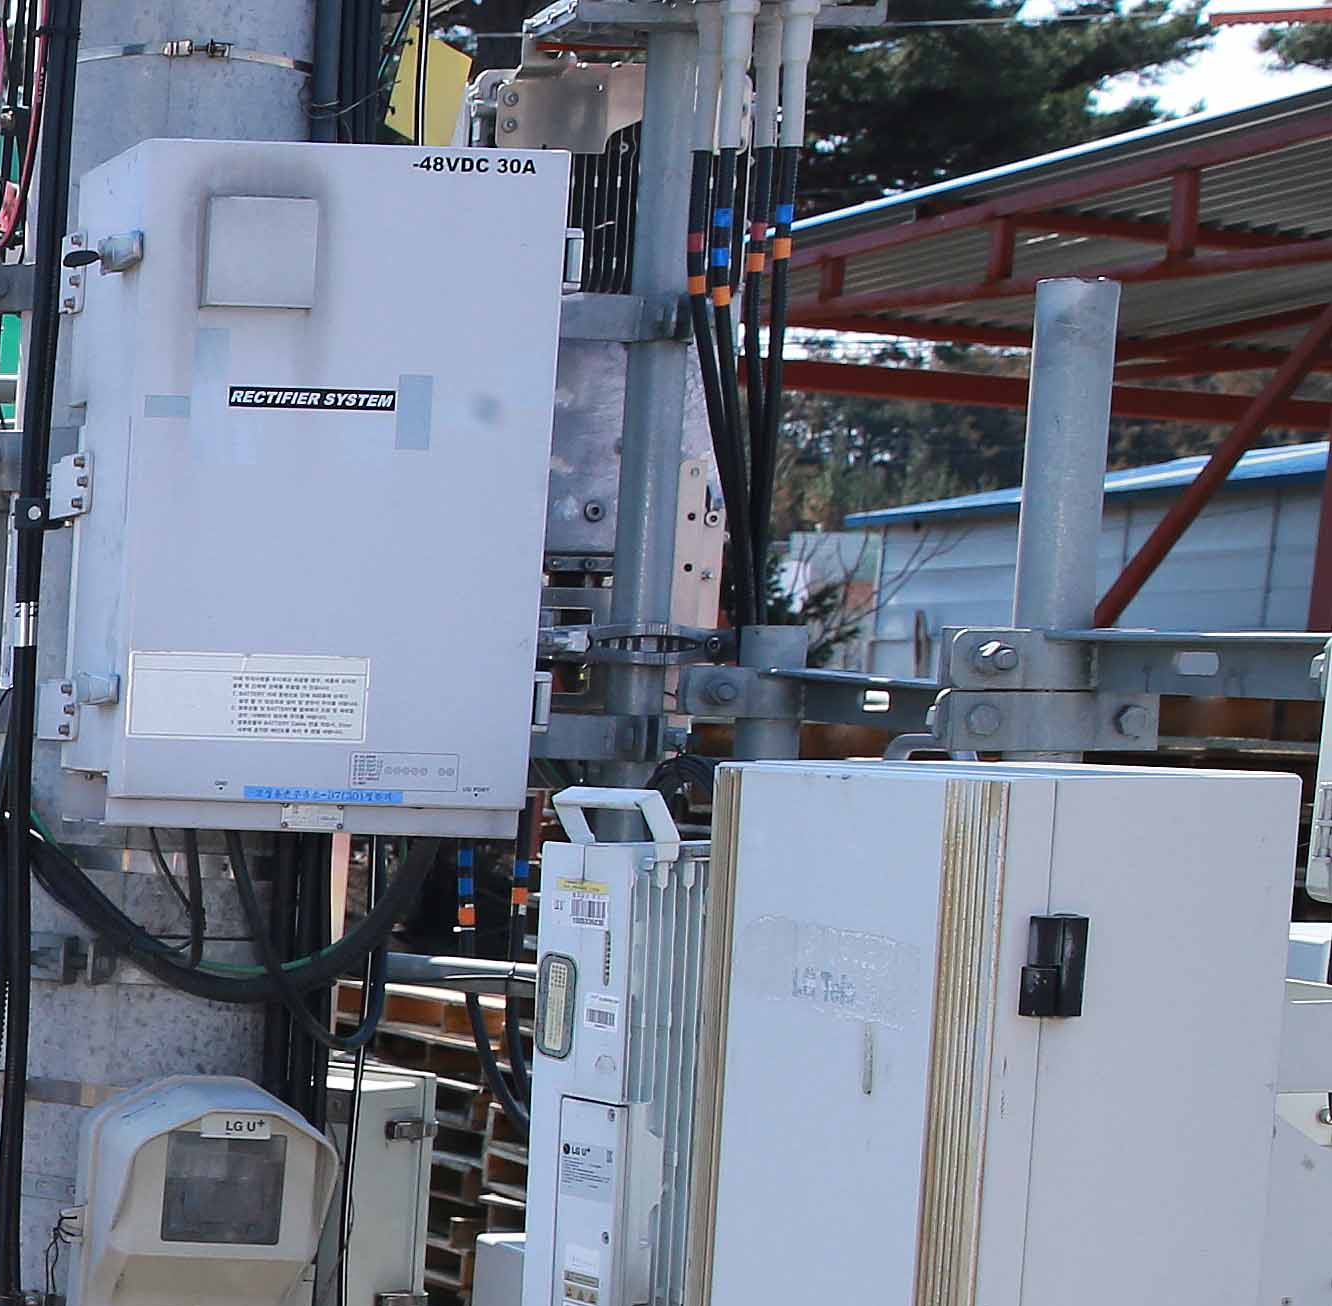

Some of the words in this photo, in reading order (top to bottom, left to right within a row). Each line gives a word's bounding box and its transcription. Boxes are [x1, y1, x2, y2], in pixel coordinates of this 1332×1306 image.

[413, 156, 489, 174] -48VDC
[496, 157, 537, 175] 30A
[230, 390, 321, 406] RECTIFIER
[323, 392, 394, 408] SYSTEM
[225, 1120, 243, 1132] LG
[247, 1119, 265, 1132] U+
[571, 1145, 581, 1156] LG
